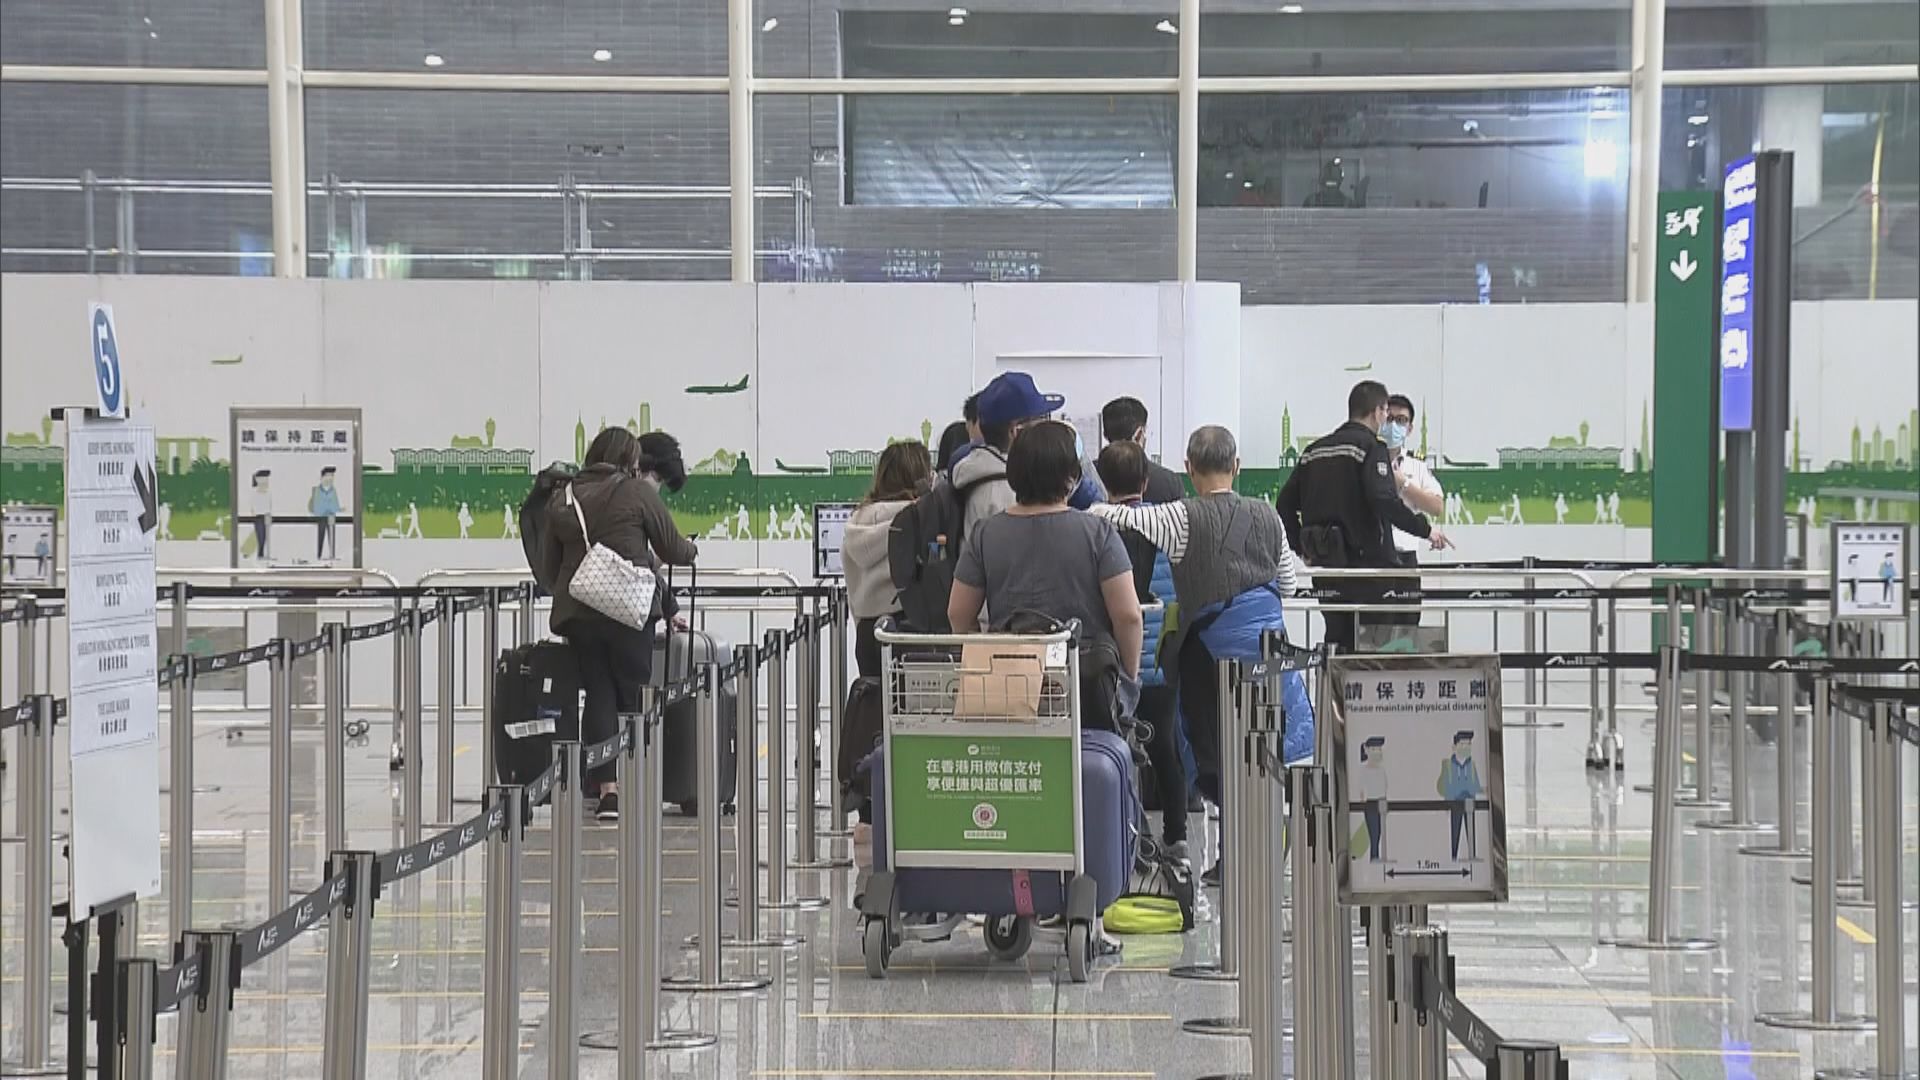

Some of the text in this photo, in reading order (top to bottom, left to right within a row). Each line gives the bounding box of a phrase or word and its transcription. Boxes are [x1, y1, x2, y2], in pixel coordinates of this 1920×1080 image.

[96, 321, 115, 395] 5
[1344, 680, 1486, 700] 請保持距離
[1345, 702, 1373, 712] Please
[1375, 702, 1413, 712] maintain
[1415, 702, 1450, 713] physical
[926, 759, 1042, 776] 在香港用微信支付
[1417, 860, 1440, 869] 1.5m
